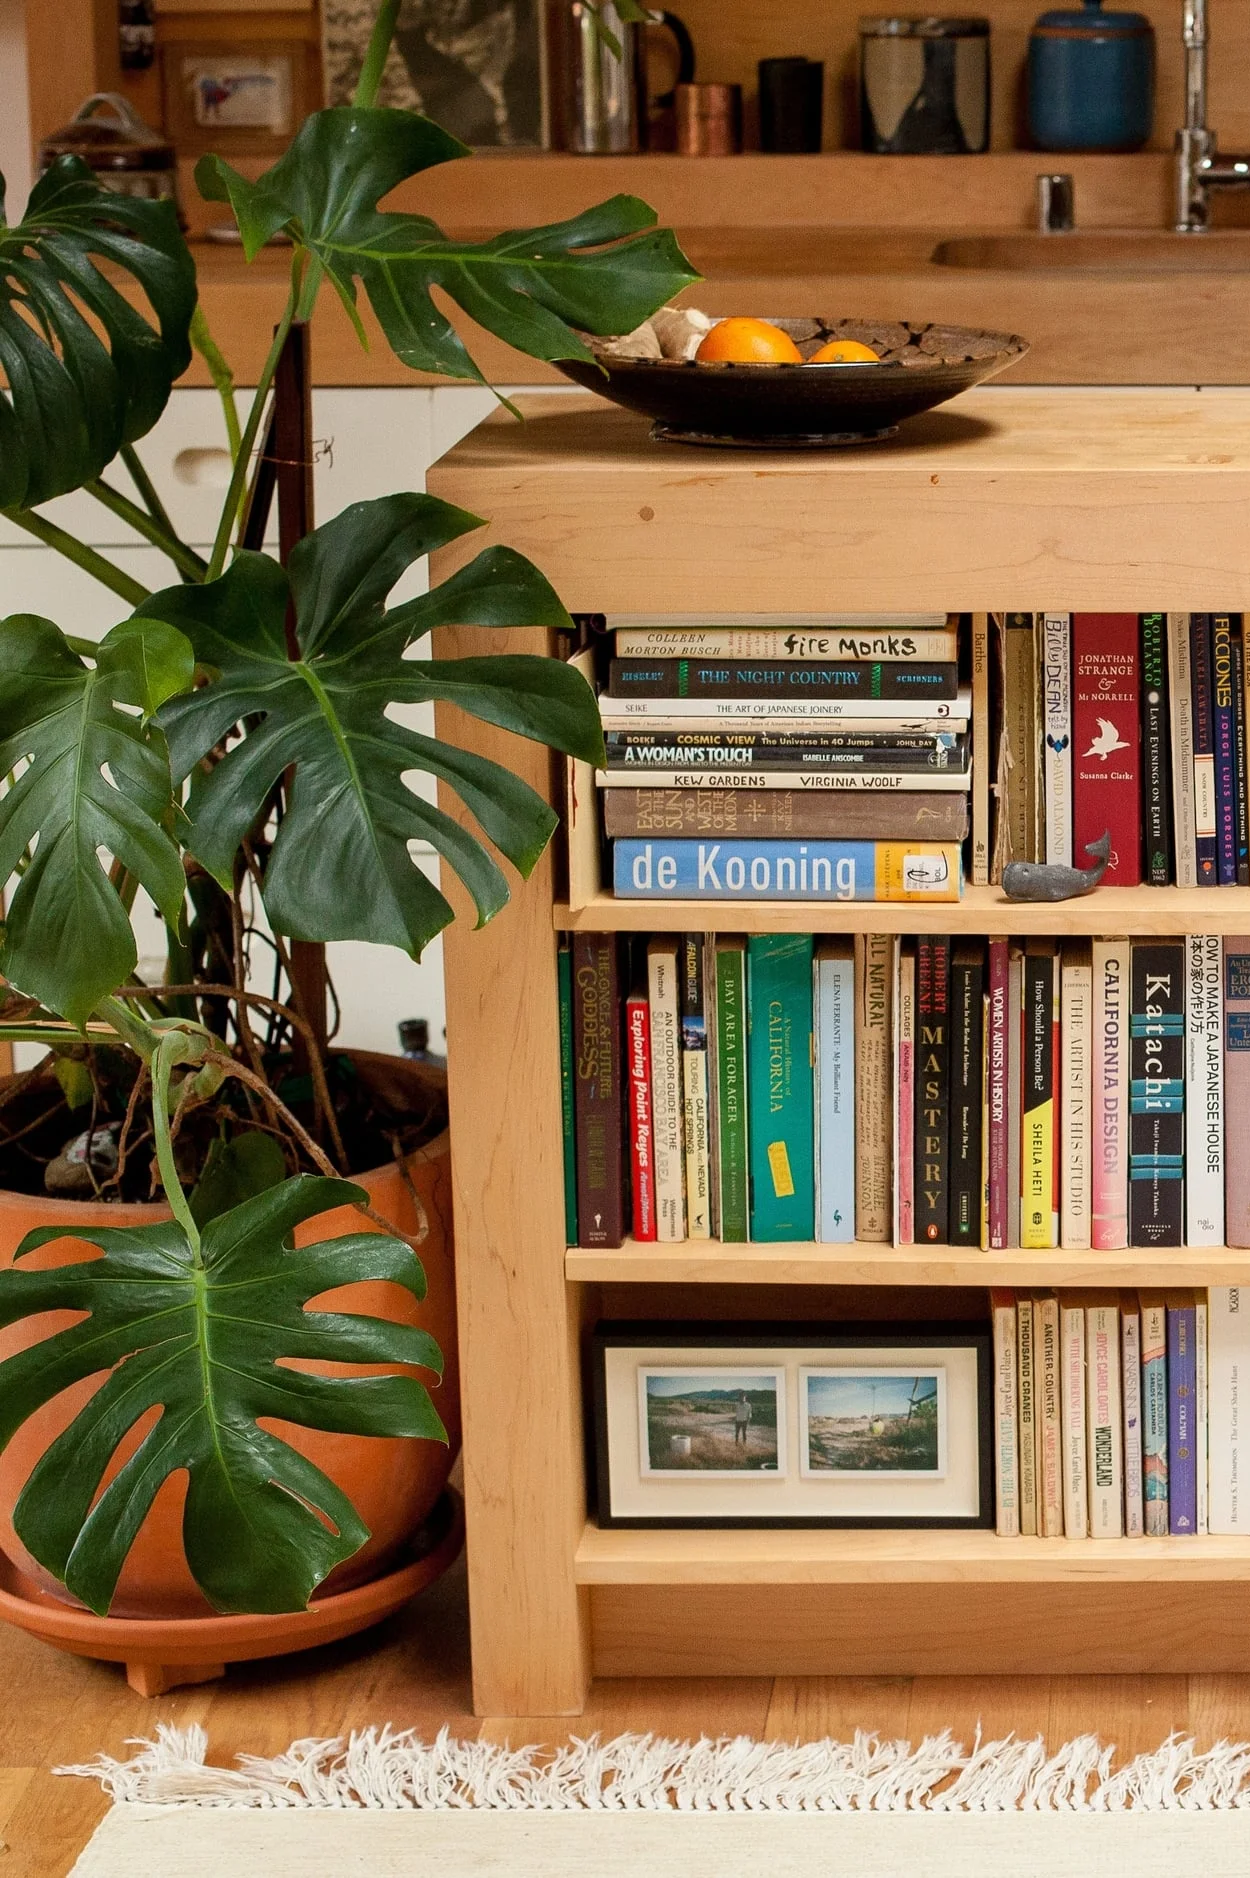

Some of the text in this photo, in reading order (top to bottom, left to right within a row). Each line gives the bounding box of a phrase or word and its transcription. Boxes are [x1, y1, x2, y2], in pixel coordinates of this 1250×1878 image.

[648, 634, 706, 642] COLLEEN
[682, 647, 721, 655] BUSCH
[784, 634, 917, 659] fire Monks
[975, 633, 985, 673] Barthes
[698, 670, 860, 685] THE NIGHT COUNTRY
[1045, 620, 1062, 713] Billy DEAN
[1078, 666, 1133, 675] STRANGE
[1079, 655, 1134, 664] JONATHAN
[1215, 618, 1231, 707] FICCIONES
[717, 705, 843, 715] THE ART OF JAPANESE JOINERY
[625, 747, 752, 762] A WOMAN'S TOUCH
[677, 736, 721, 745] COSMIC
[726, 736, 756, 744] VIEW
[780, 738, 817, 746] Universe
[847, 738, 874, 747] Jumps
[674, 776, 903, 787] KEW GARDENS VIRGINIA WOOLF
[1149, 708, 1161, 837] LAST EVENINGS ON EARTH
[633, 845, 856, 900] de Kooning
[1035, 980, 1044, 1001] How
[1207, 965, 1219, 983] TO
[1035, 1004, 1044, 1035] Should
[1207, 991, 1219, 1031] MAKE
[725, 979, 737, 1124] BAY AREA FORAGER
[768, 1001, 783, 1113] CALIFORNIA
[992, 987, 1004, 1124] WOMEN ARTISTS IN HISTORY
[1034, 1043, 1044, 1073] Person
[1145, 973, 1171, 1110] Katachi
[1207, 1033, 1219, 1043] A
[1035, 1074, 1044, 1091] Be?
[1104, 959, 1119, 1175] CALIFORNIA DESIGN
[1206, 1044, 1219, 1121] JAPANESE
[631, 1010, 649, 1167] Exploring Point Reyes
[1032, 1124, 1043, 1196] SHEILA HETI
[1207, 1124, 1220, 1174] HOUSE
[1022, 1320, 1031, 1423] THOUSAND CRANES
[1095, 1426, 1112, 1487] WONDERLAND
